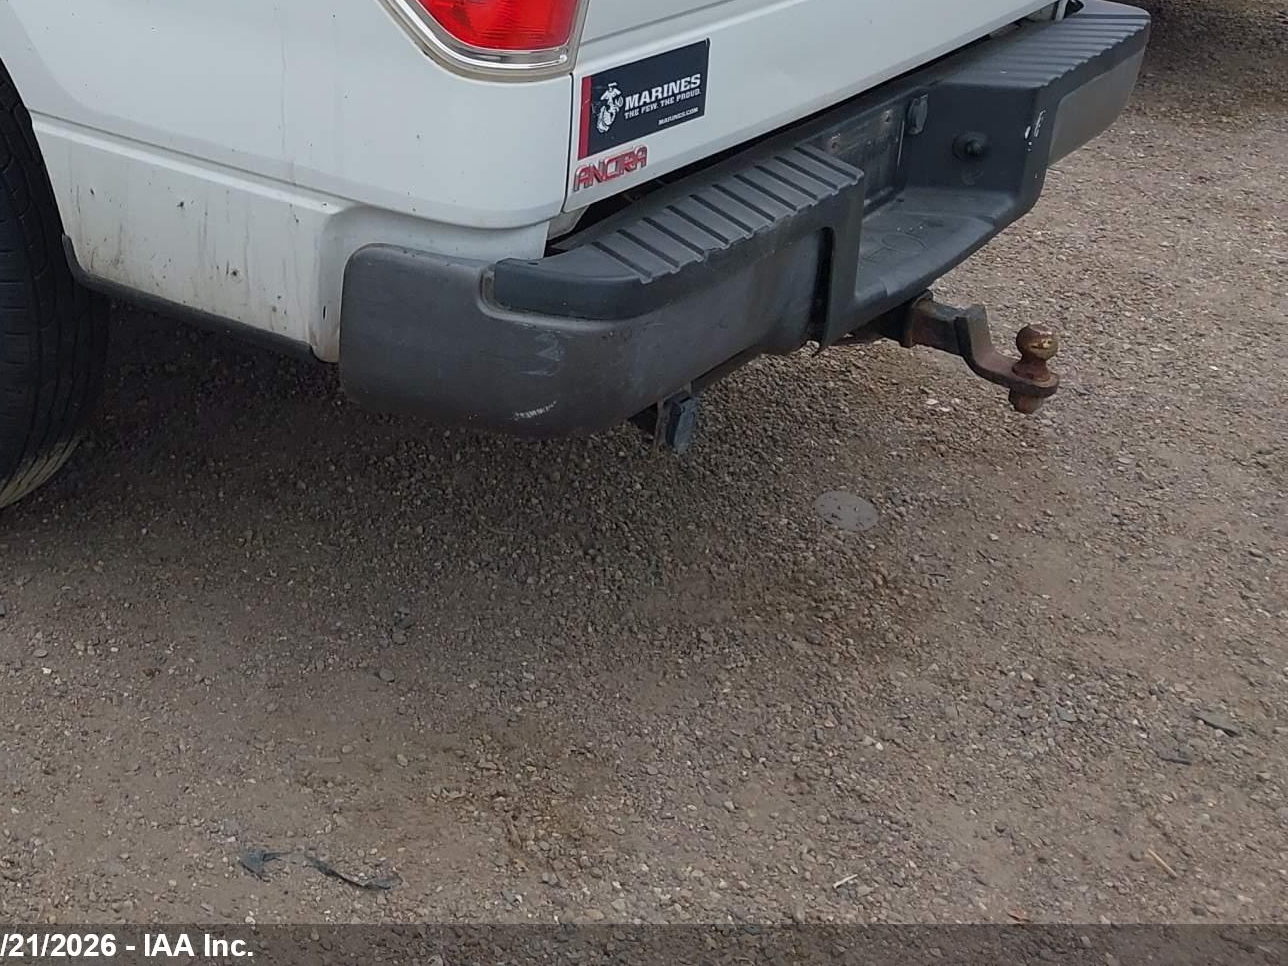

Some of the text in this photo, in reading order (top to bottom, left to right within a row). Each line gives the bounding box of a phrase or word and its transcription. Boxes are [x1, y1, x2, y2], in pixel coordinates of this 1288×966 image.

[624, 74, 701, 111] MARINES
[624, 109, 639, 119] THE
[660, 97, 674, 107] THE
[676, 89, 701, 103] PROUD.
[658, 107, 699, 125] MARINES.COM
